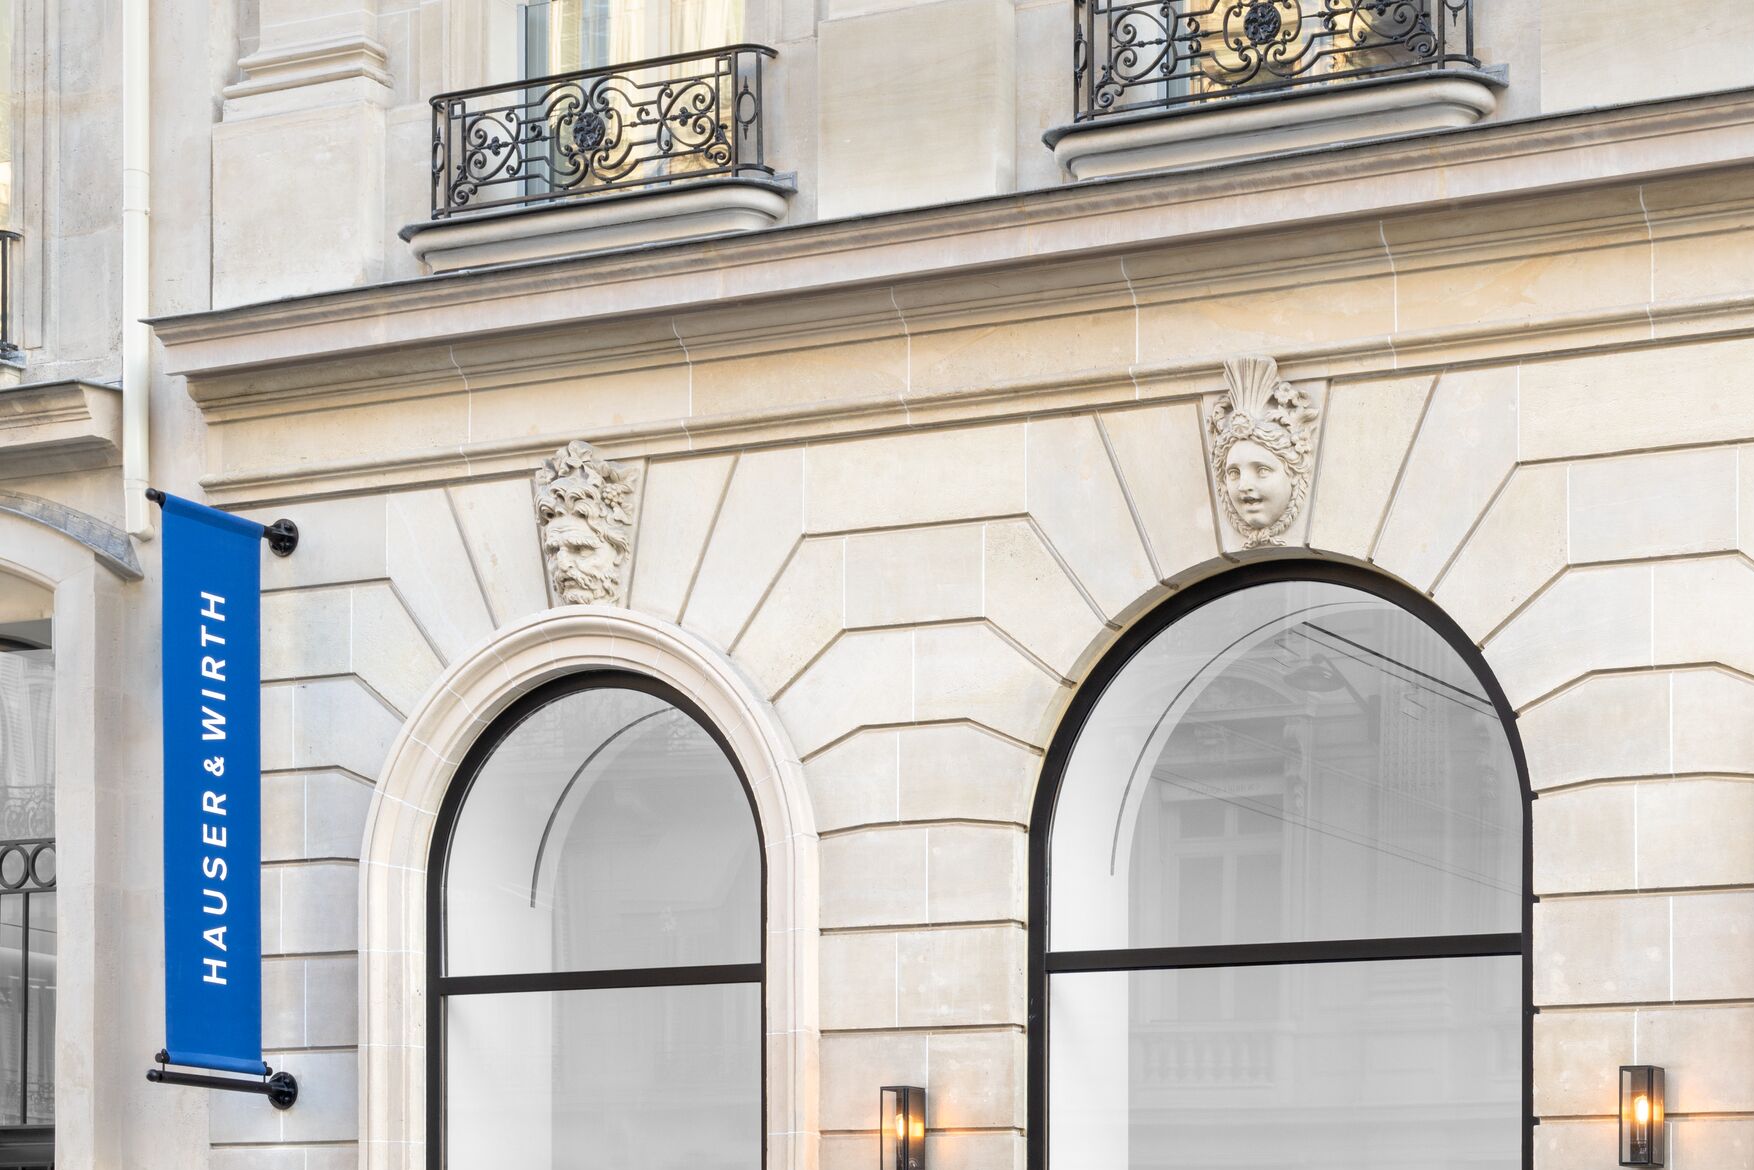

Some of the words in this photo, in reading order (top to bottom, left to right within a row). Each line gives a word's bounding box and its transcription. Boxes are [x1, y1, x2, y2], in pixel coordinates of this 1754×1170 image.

[200, 591, 226, 741] WIRTH
[203, 756, 225, 777] &
[202, 789, 228, 986] HAUSER
